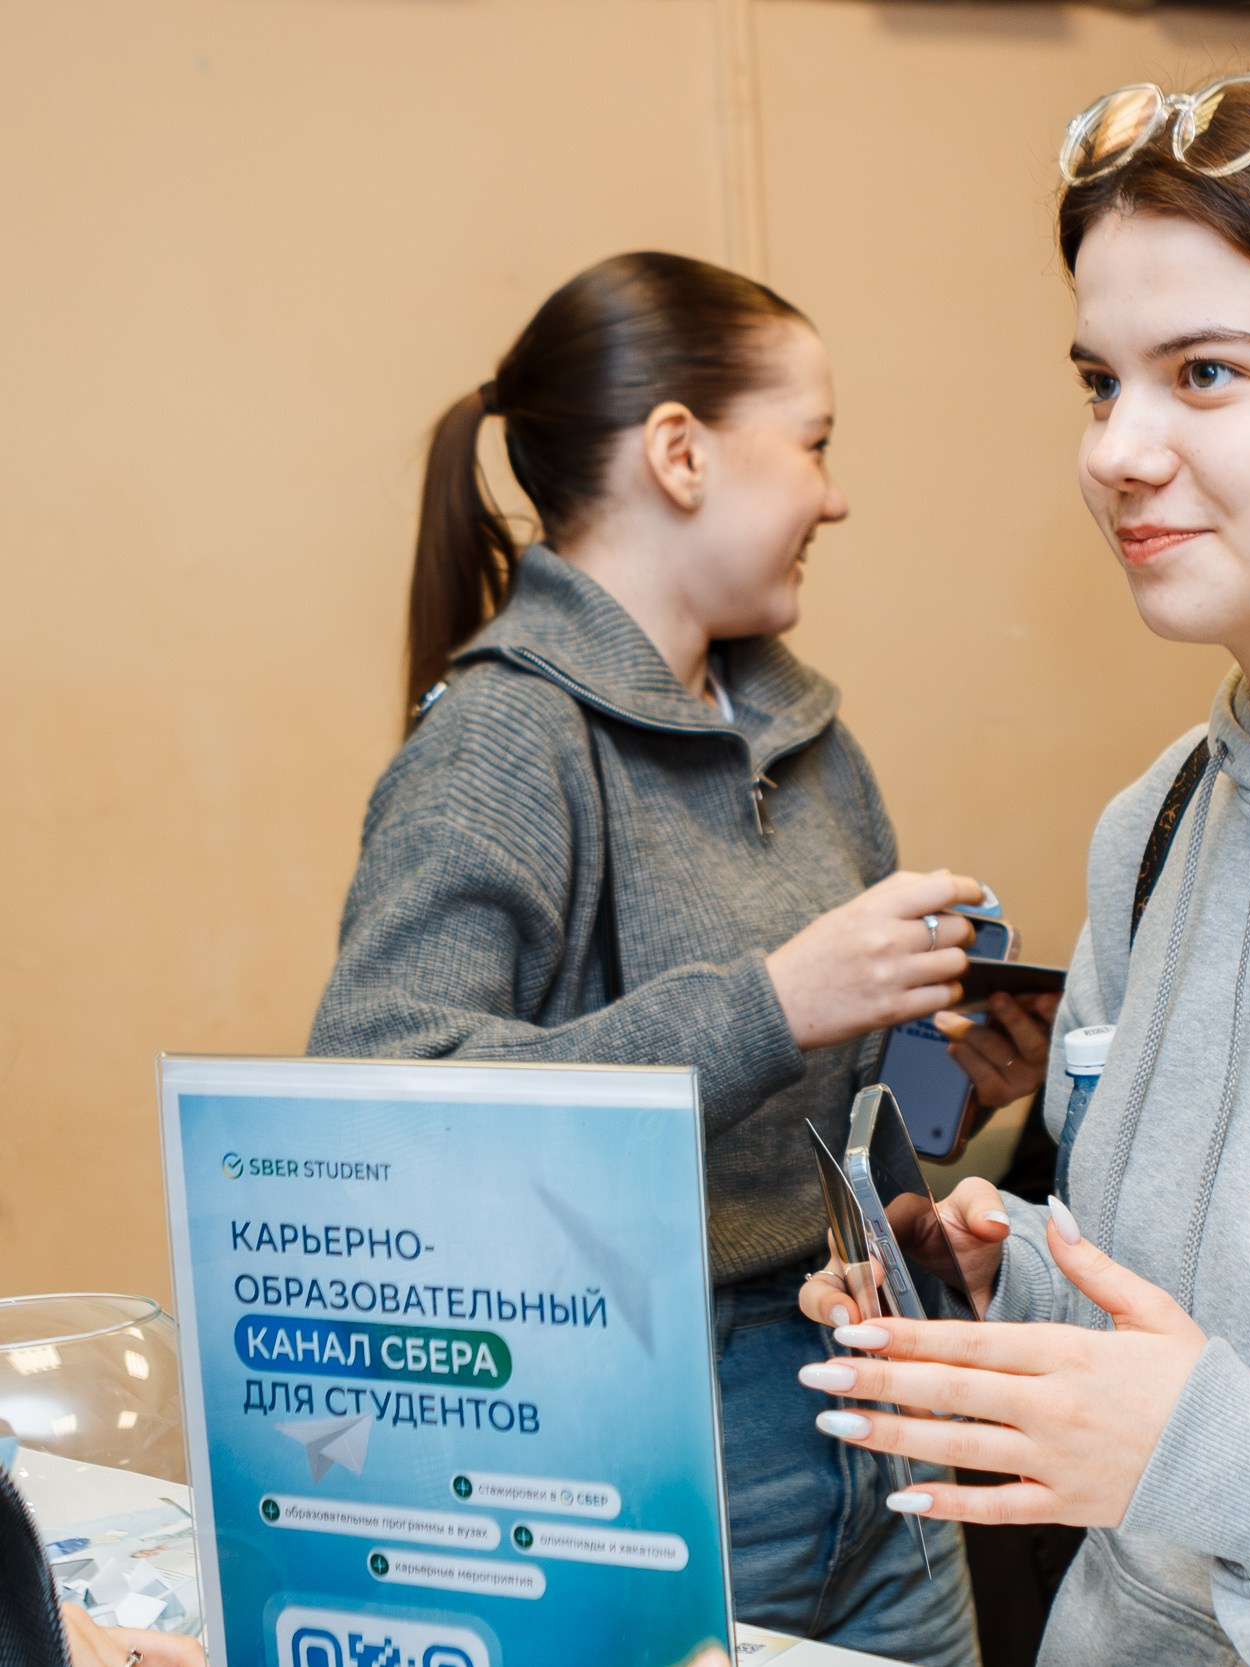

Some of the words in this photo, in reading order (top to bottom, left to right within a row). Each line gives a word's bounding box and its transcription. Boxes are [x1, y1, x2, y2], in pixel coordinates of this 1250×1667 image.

[249, 1157, 299, 1178] SBER
[303, 1161, 391, 1182] STUDENT
[231, 1221, 435, 1260] КАРЬЕРНО-
[234, 1274, 608, 1329] ОБРАЗОВАТЕЛЬНЫЙ
[247, 1327, 371, 1369] КАНАЛ
[381, 1336, 498, 1378] СБЕРА
[243, 1380, 314, 1415] ДЛЯ
[325, 1387, 541, 1434] СТУДЕНТОВ
[478, 1484, 547, 1501] стажировки
[577, 1492, 609, 1508] СБЕР
[285, 1504, 379, 1527] образовательные
[382, 1517, 445, 1534] программы
[457, 1526, 488, 1540] вузах
[540, 1535, 606, 1552] олимпиады
[620, 1544, 677, 1559] хакатоны
[395, 1562, 455, 1579] карьерные
[458, 1569, 533, 1588] мероприятия
